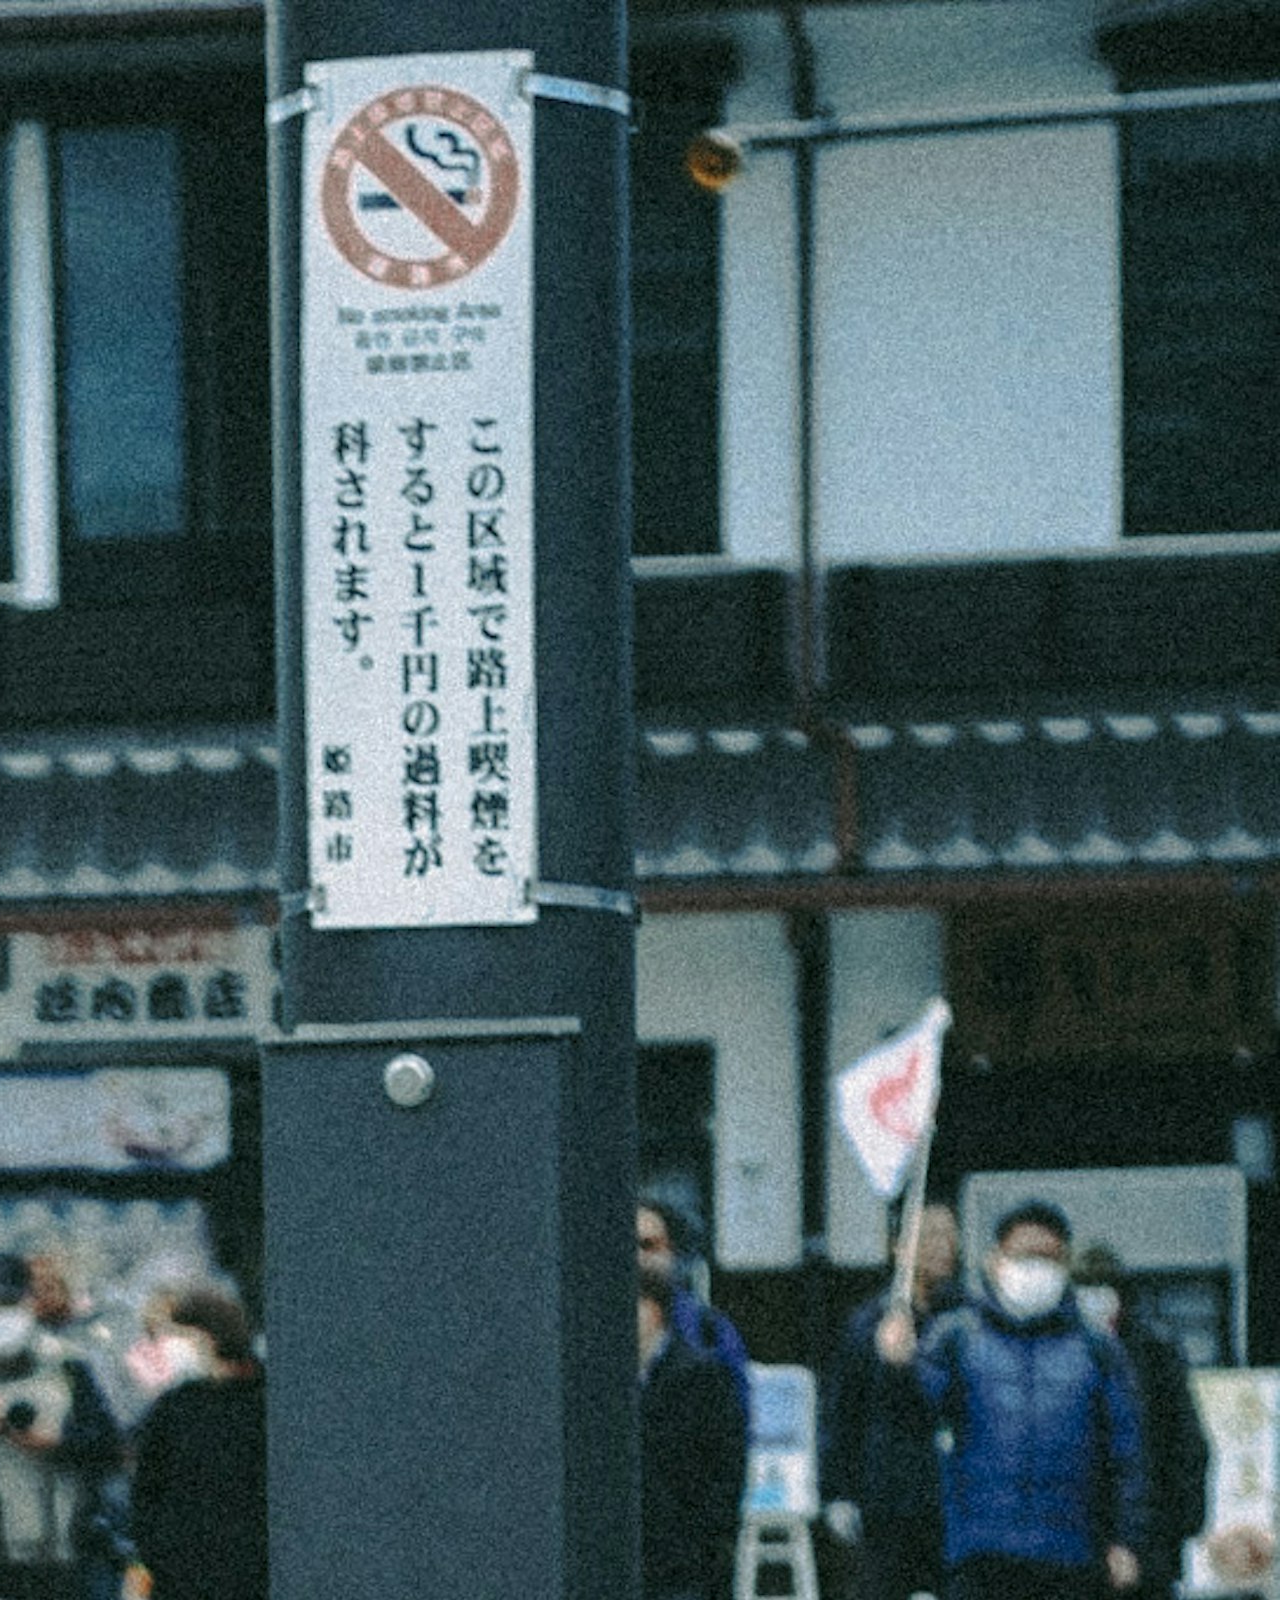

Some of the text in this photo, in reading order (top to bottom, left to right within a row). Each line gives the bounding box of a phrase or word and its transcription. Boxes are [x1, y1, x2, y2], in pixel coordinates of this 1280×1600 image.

[467, 417, 509, 877] この区域で路上喫煙を
